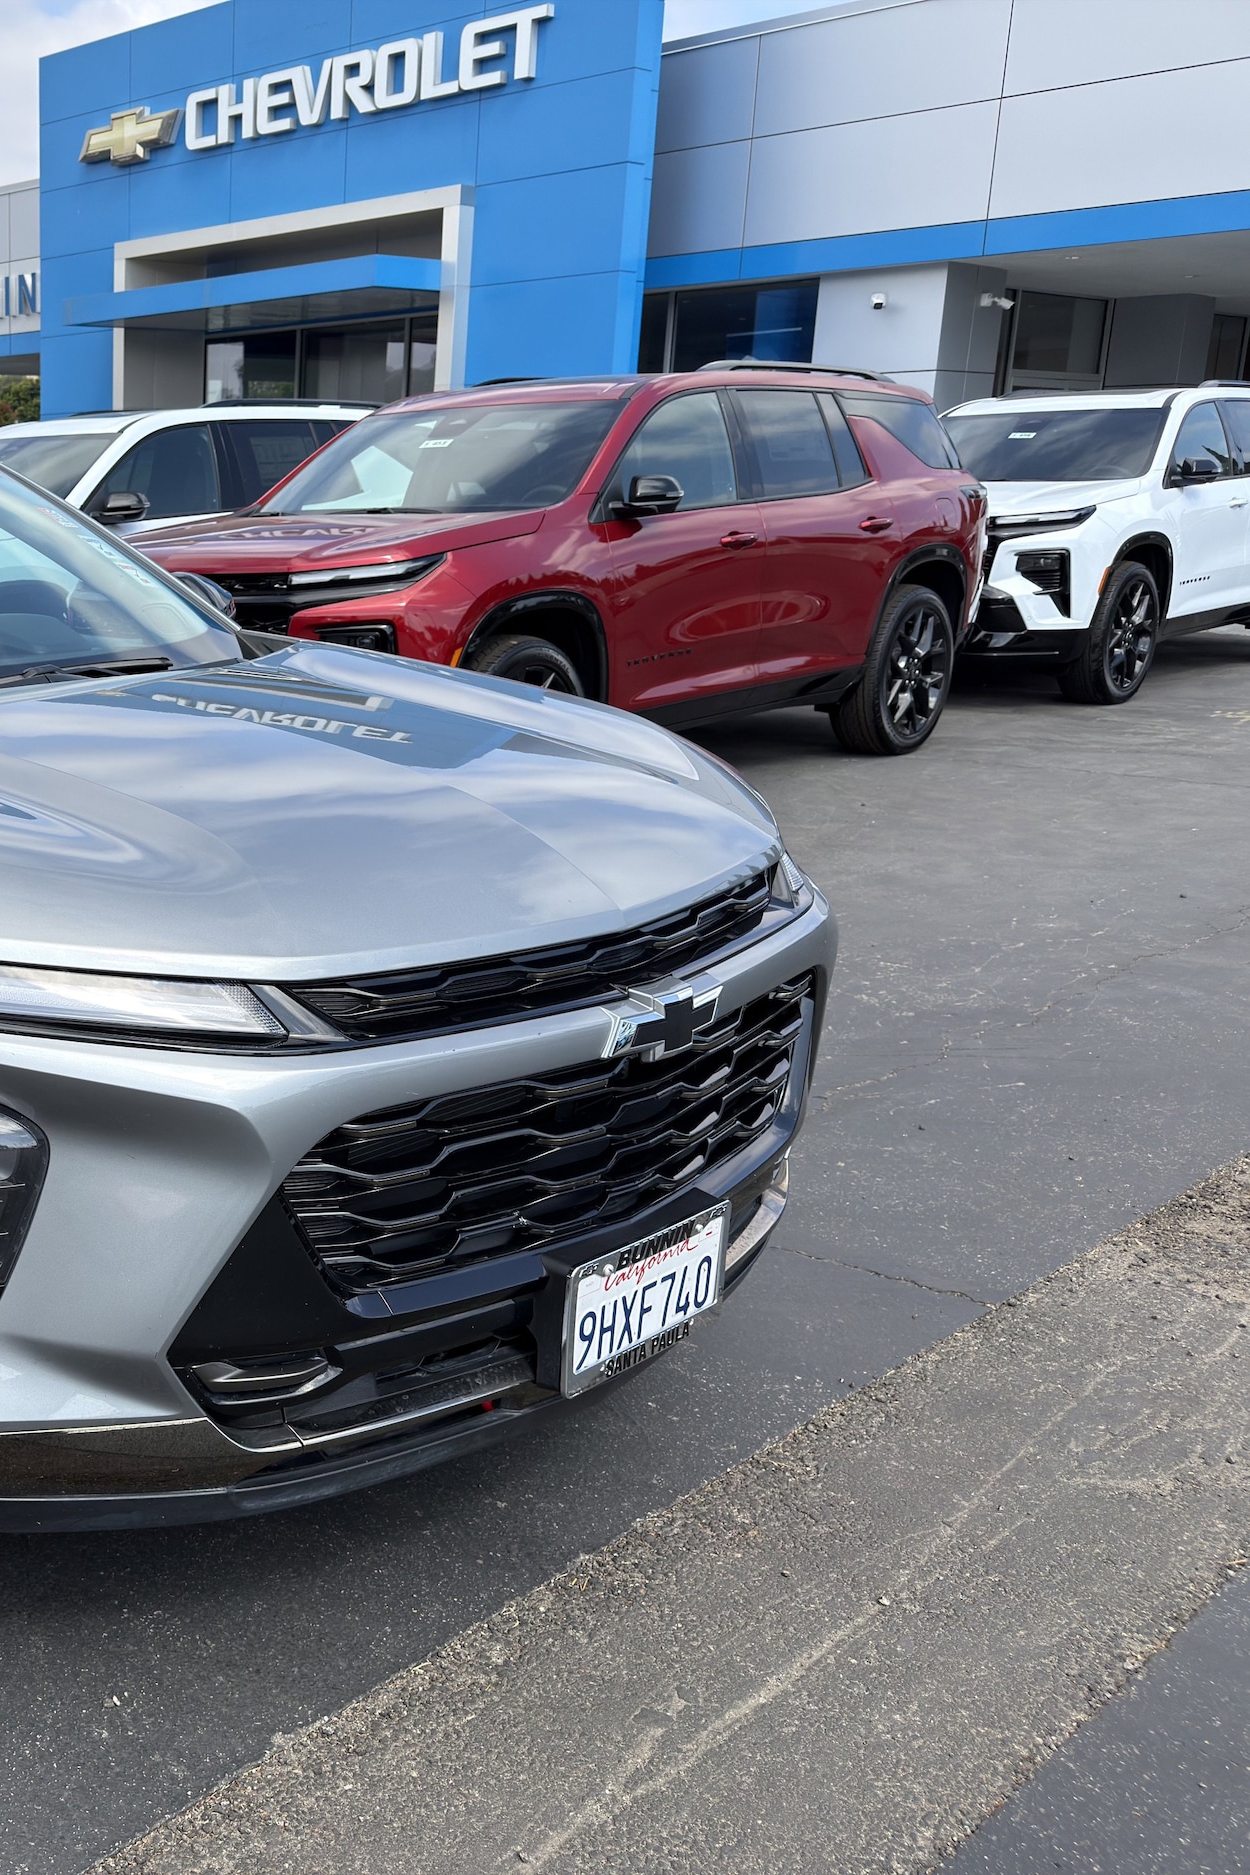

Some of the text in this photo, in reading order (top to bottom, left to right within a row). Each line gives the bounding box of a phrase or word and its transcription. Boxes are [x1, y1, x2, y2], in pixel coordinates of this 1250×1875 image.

[184, 3, 555, 151] CHEVROLET
[605, 1239, 699, 1292] California
[617, 1220, 696, 1266] BUNNIN
[576, 1255, 712, 1371] 9HXF740
[605, 1320, 690, 1377] SANTA PAULA
